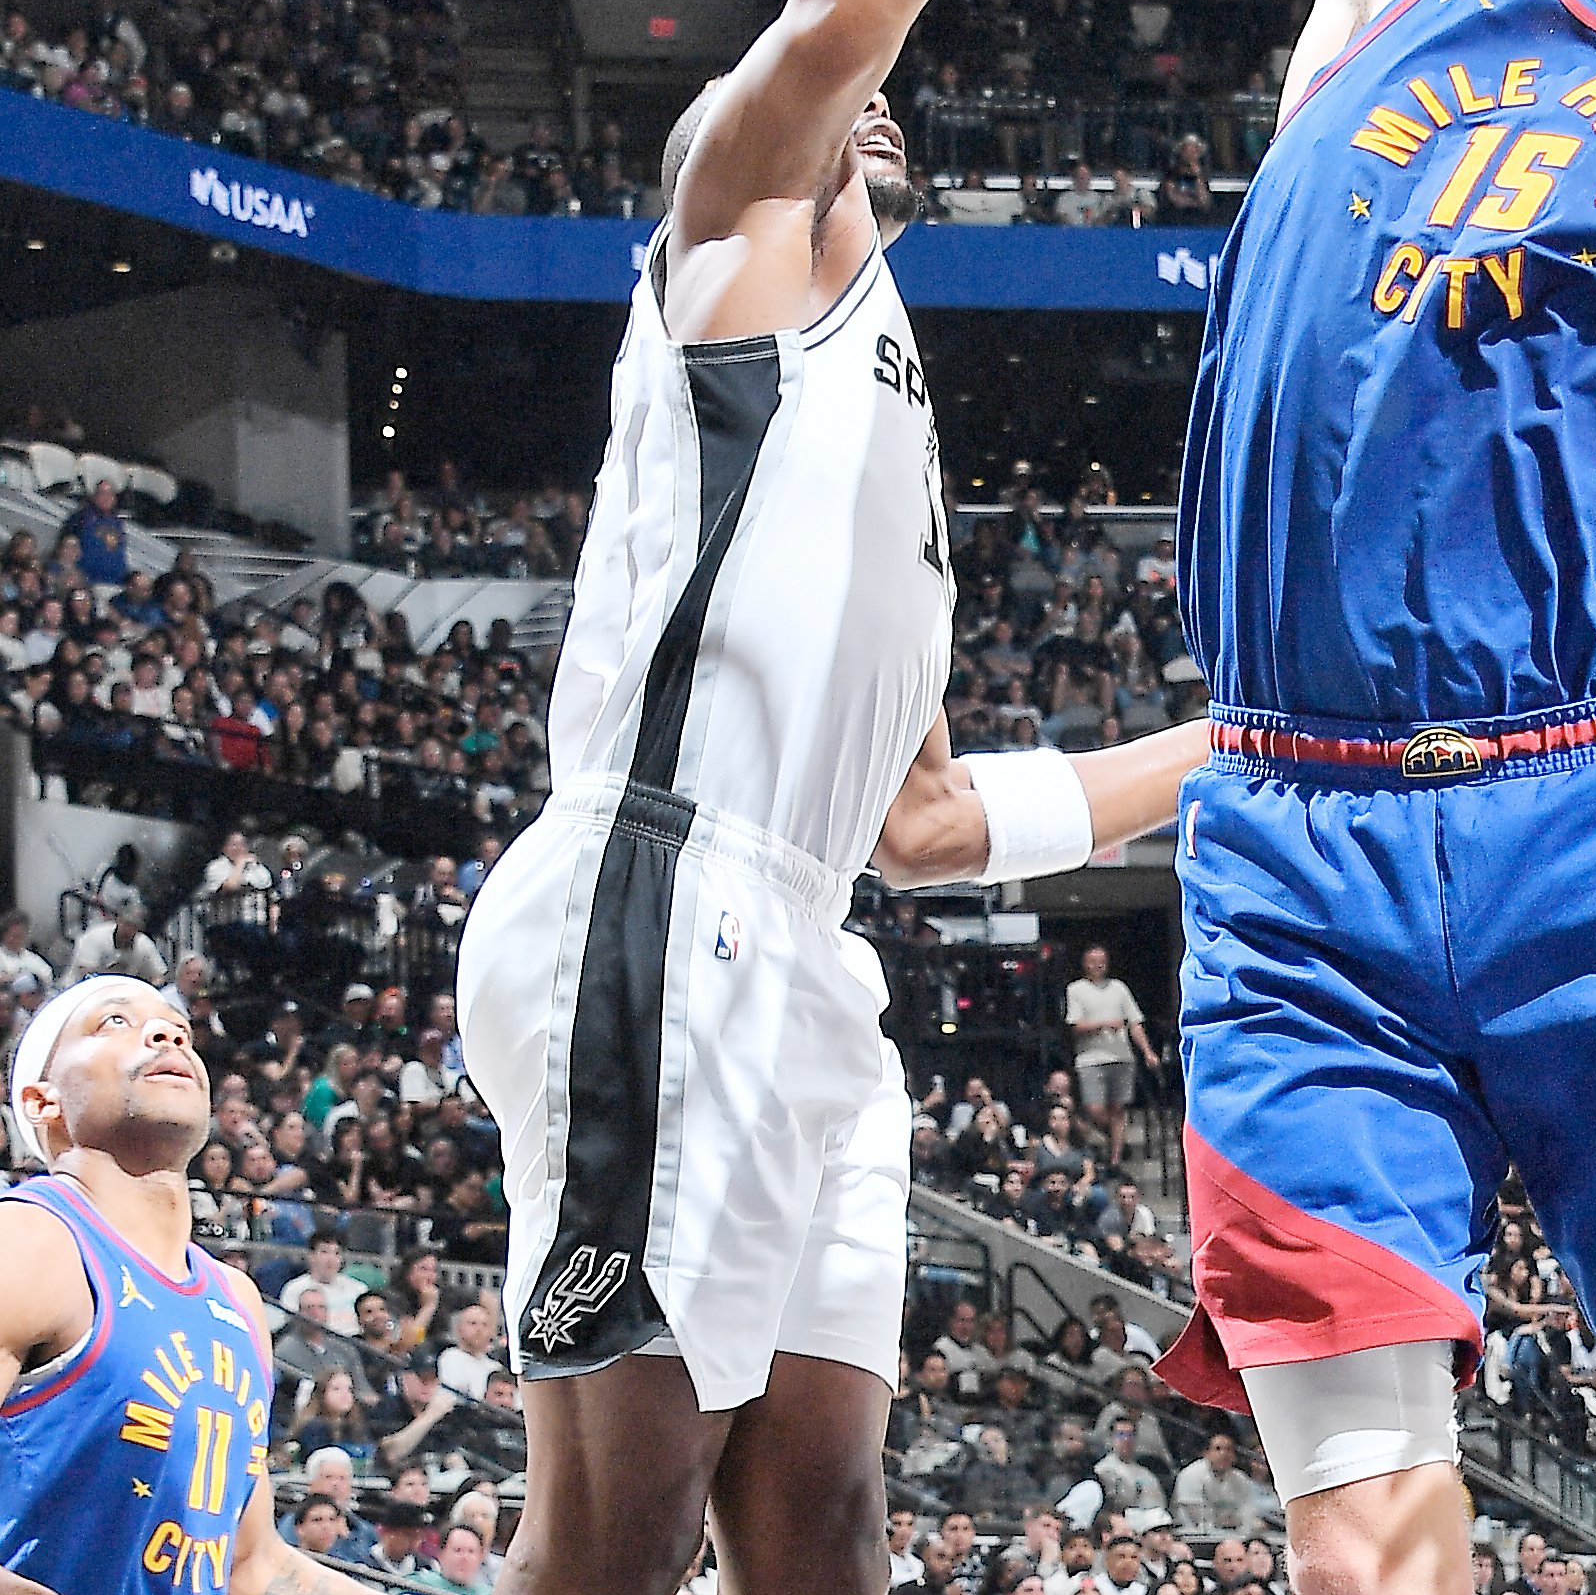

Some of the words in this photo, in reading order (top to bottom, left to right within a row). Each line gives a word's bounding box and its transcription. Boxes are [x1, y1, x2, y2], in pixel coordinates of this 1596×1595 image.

[1350, 58, 1543, 168] MILE
[1428, 123, 1583, 232] 15
[1372, 241, 1526, 330] CITY
[118, 1330, 204, 1452] MILE
[187, 1405, 233, 1515] 11
[142, 1519, 229, 1595] CITY
